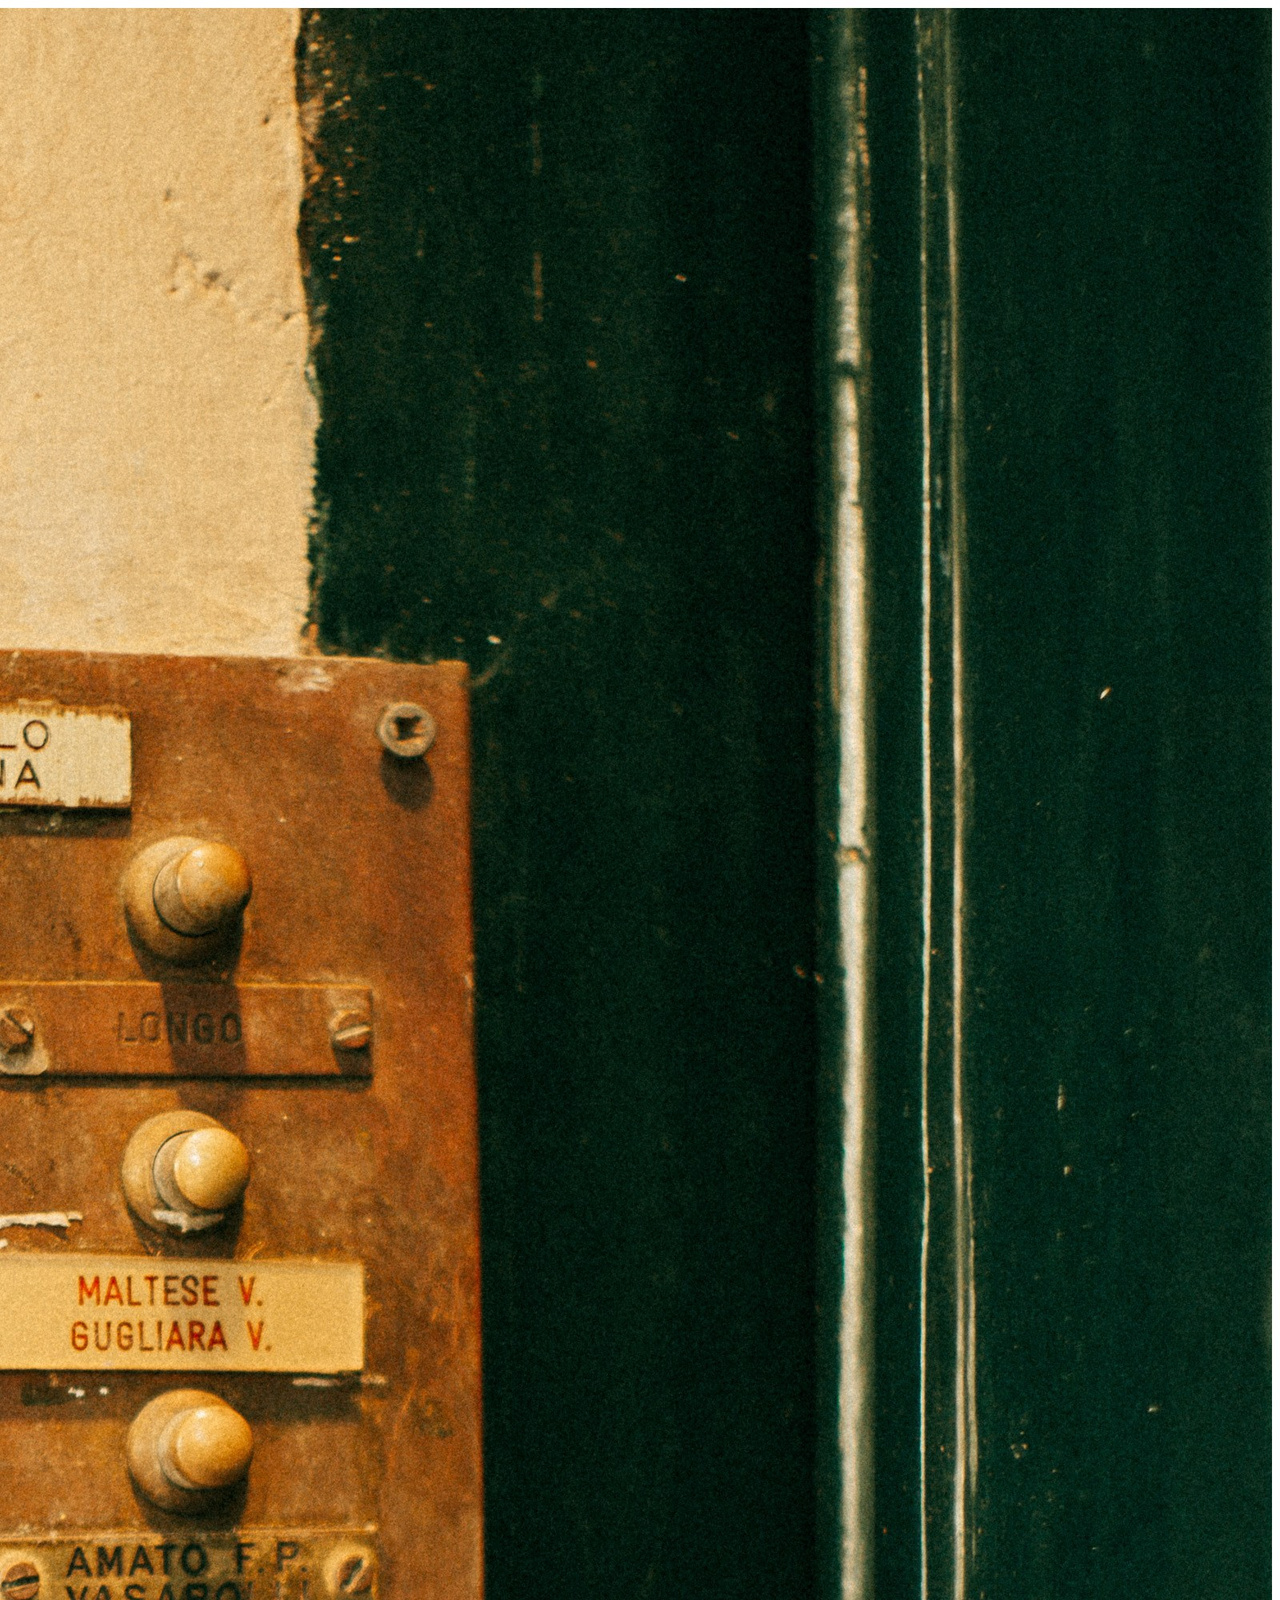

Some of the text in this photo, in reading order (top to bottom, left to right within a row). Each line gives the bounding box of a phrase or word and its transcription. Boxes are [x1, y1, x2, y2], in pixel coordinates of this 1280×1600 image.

[117, 1011, 242, 1046] LONGO
[77, 1273, 264, 1308] MALTESE V.
[70, 1319, 273, 1353] GUGLIARA V.
[65, 1541, 210, 1578] AMATO
